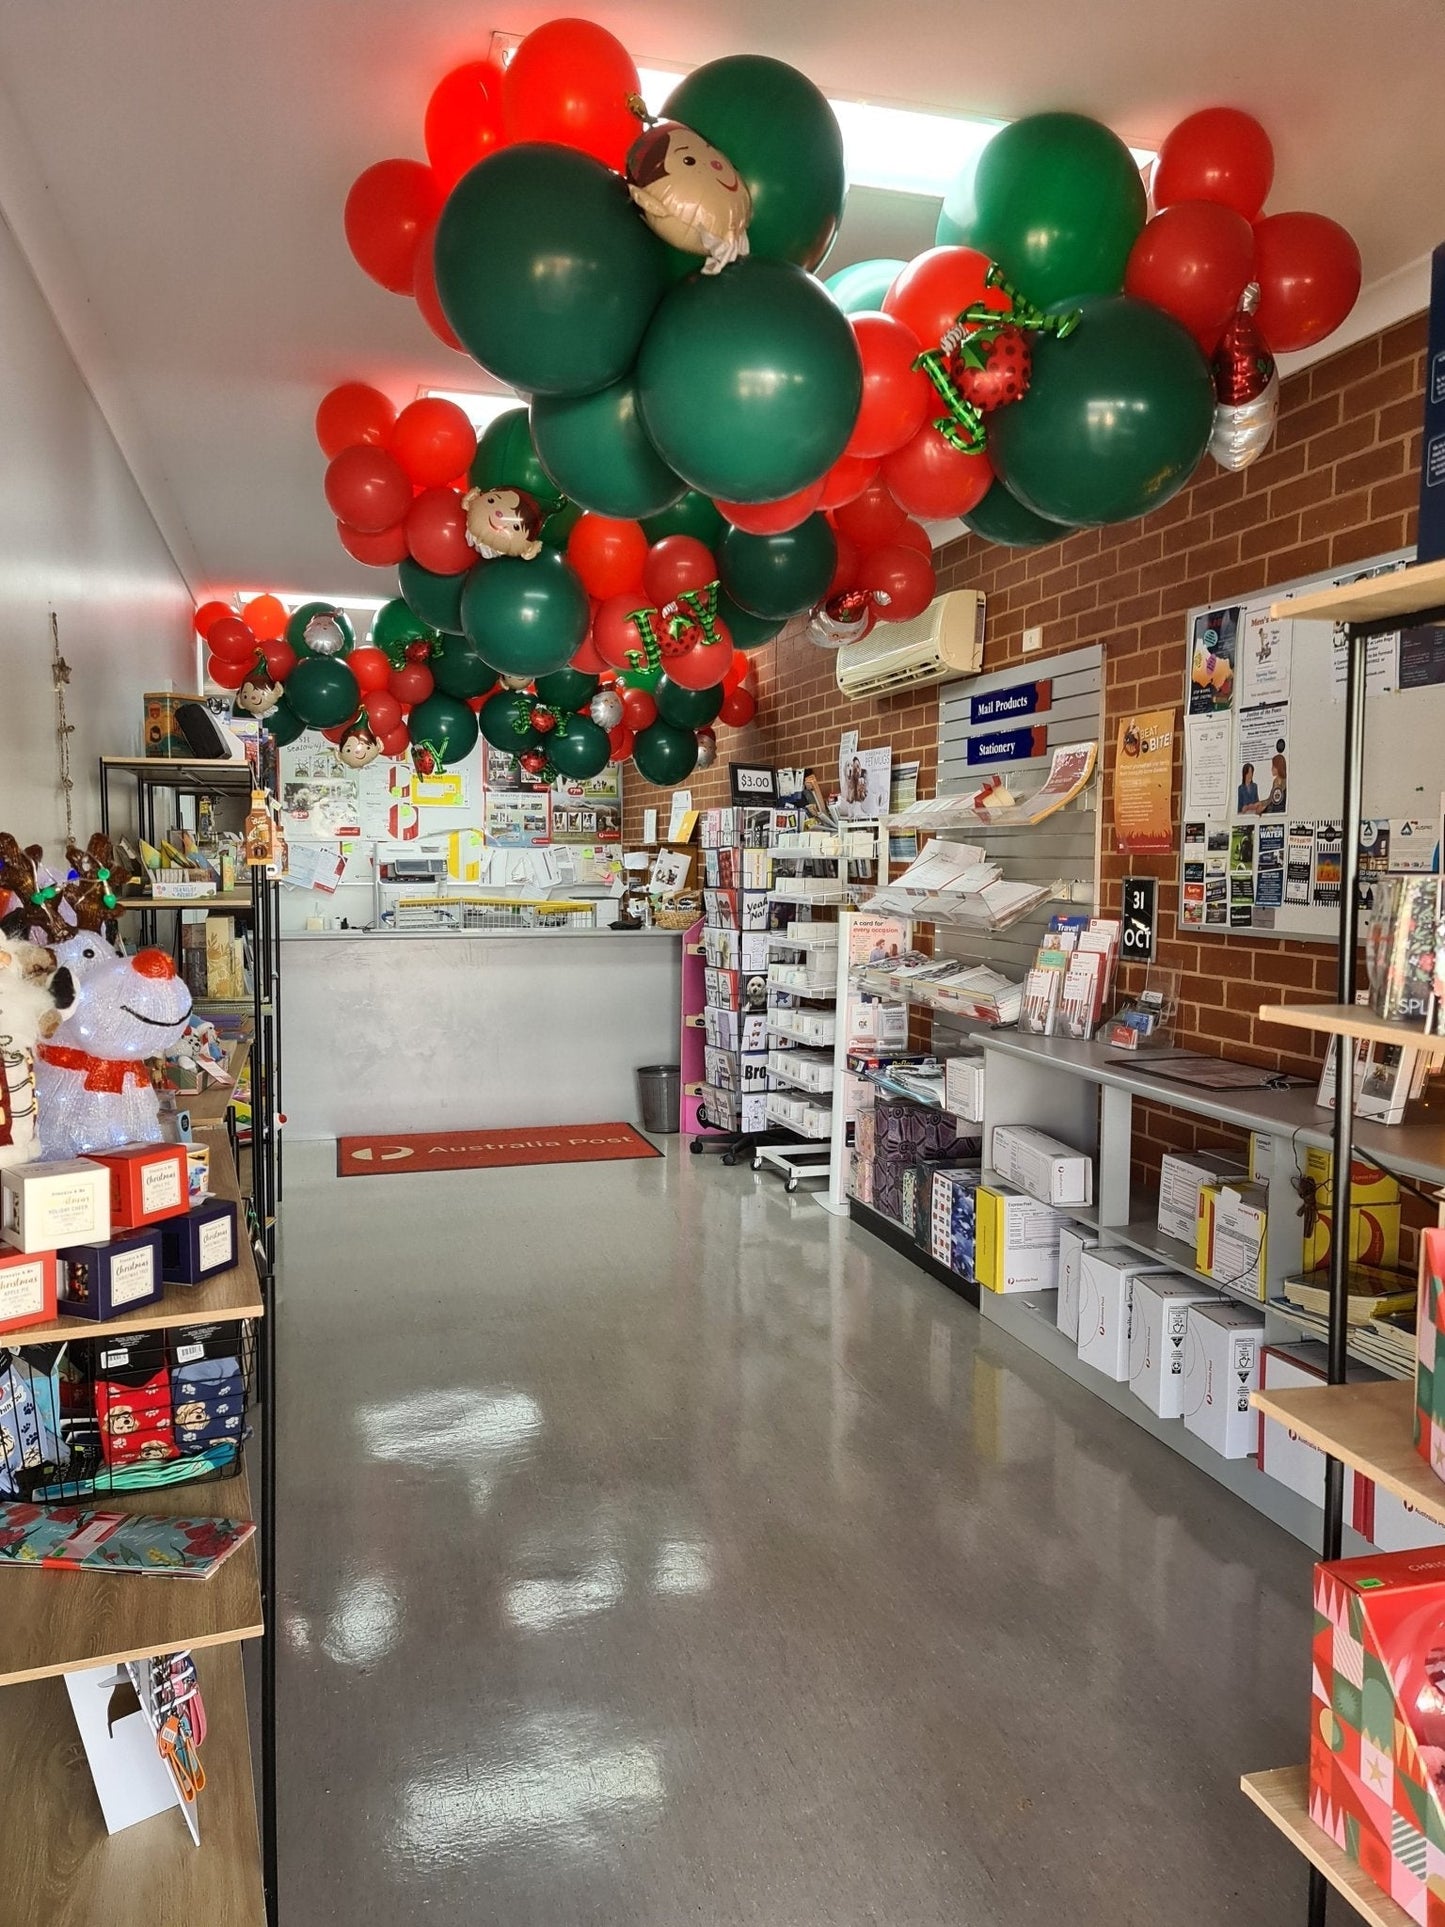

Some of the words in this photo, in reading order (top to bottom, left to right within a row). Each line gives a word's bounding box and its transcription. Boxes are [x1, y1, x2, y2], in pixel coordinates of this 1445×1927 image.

[977, 700, 994, 716] Mail
[995, 696, 1028, 712] Products
[1140, 724, 1159, 740] BEAT
[978, 742, 1016, 757] Stationery
[1150, 731, 1173, 753] BITE!
[741, 773, 770, 788] $3.00
[1260, 830, 1283, 839] WATER
[1133, 890, 1145, 910] 31
[1057, 923, 1080, 932] Travel
[1124, 928, 1151, 949] OCT
[744, 1065, 767, 1080] Bro
[427, 1140, 561, 1154] Australia
[567, 1135, 635, 1147] Post
[146, 1171, 176, 1186] Christmas
[203, 1229, 228, 1244] Christmas
[115, 1259, 149, 1276] Christmas
